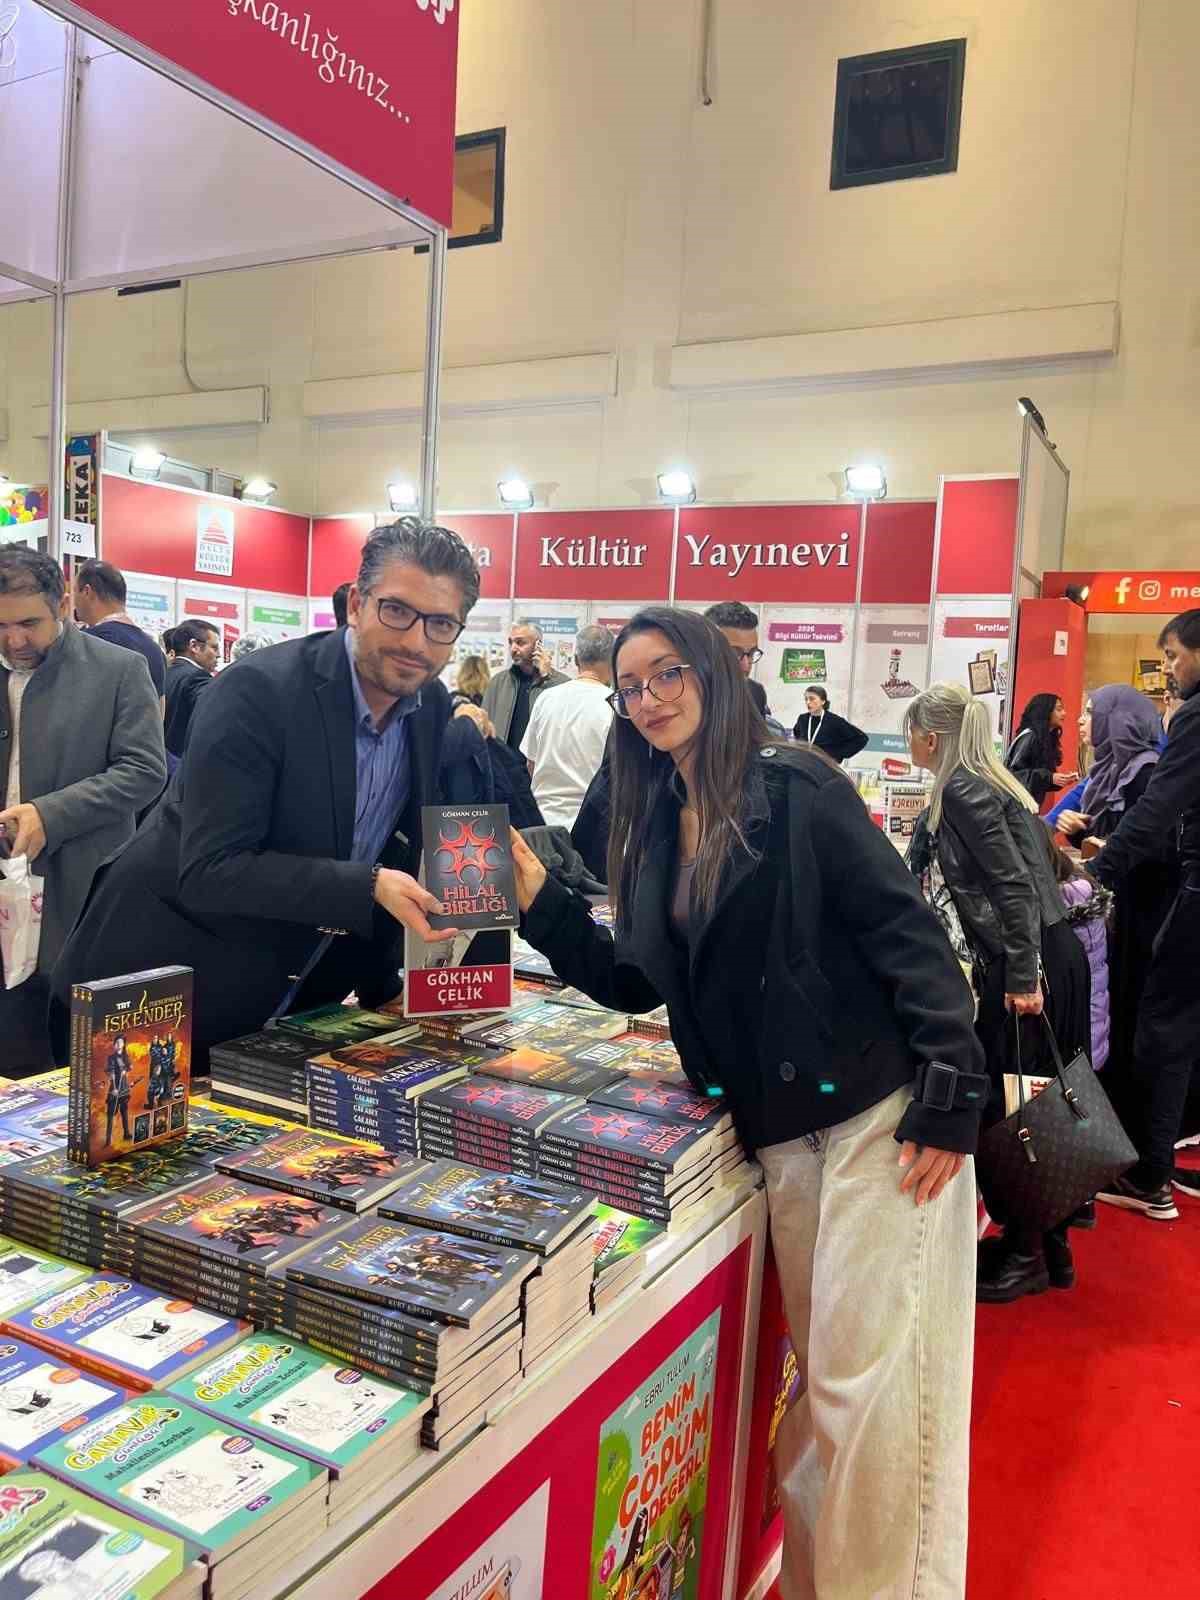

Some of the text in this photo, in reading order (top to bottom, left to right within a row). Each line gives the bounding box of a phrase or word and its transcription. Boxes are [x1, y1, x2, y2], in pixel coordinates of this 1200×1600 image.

[65, 532, 83, 543] 723
[540, 536, 648, 567] Kültür
[684, 532, 849, 577] Yayınevi
[443, 884, 501, 900] HİLAL
[427, 970, 493, 987] GÖKHAN
[438, 985, 483, 1005] ÇELİK
[105, 999, 187, 1033] İSKENDER
[643, 1351, 691, 1408] EBRU TULUM
[641, 1371, 696, 1457] BENİM
[619, 1391, 709, 1544] ÇÖPÜM
